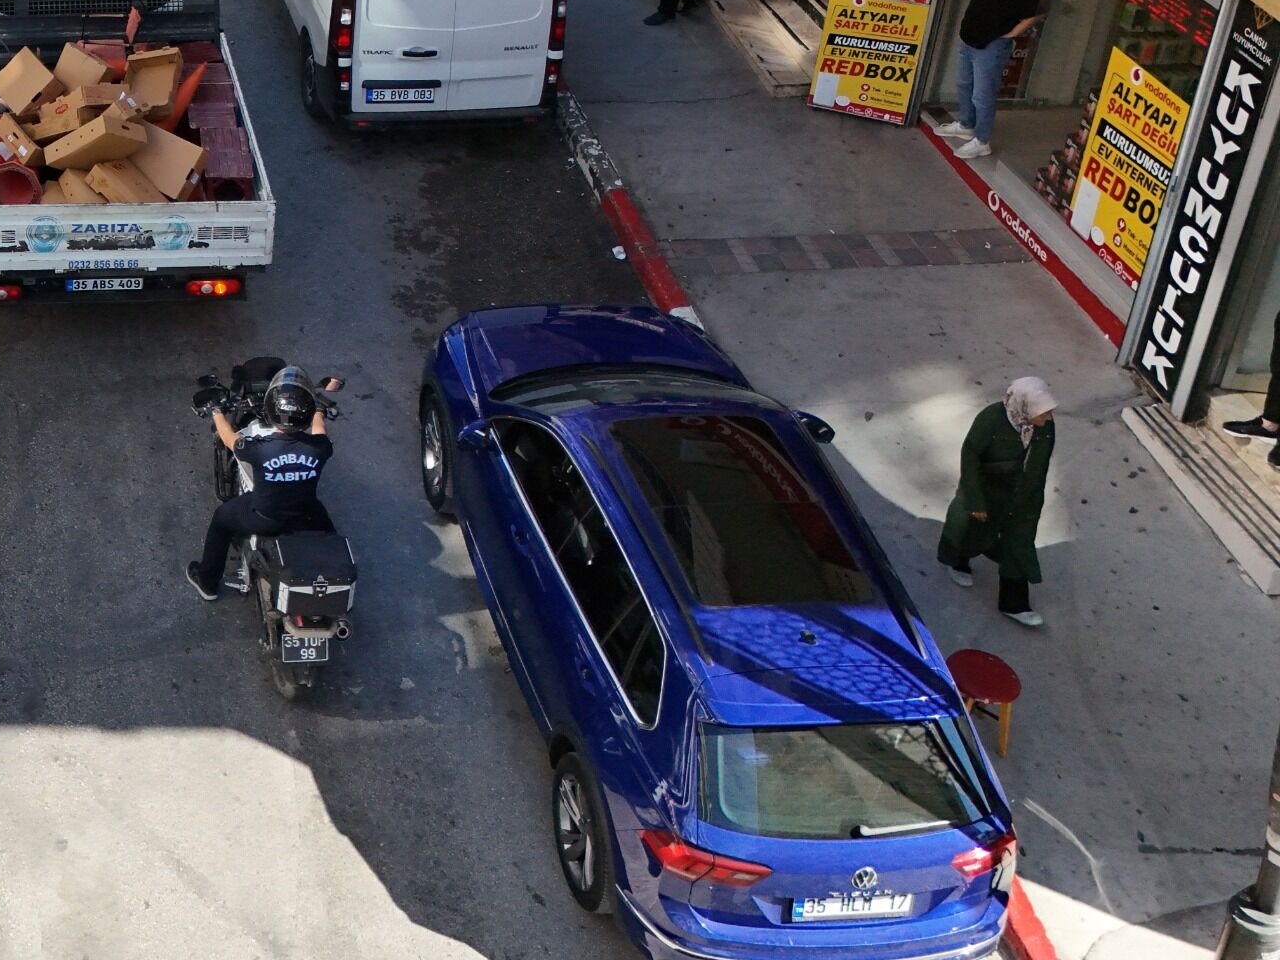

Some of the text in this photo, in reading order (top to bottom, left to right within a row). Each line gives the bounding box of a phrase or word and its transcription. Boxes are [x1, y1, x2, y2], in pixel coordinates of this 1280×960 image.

[867, 0, 907, 13] vodafone
[837, 8, 906, 25] ALTYAPI
[833, 19, 919, 38] ŞART DEĞİL!
[833, 35, 911, 54] KURULUMSUZ
[1244, 27, 1268, 50] CANSU
[503, 44, 540, 52] RENAULT
[830, 47, 847, 56] EV
[1232, 31, 1273, 66] KUYUMCULUK
[819, 57, 914, 84] REDBOX
[373, 90, 386, 101] 35
[1144, 78, 1182, 115] vodafone
[1112, 81, 1179, 135] ALTYAPI
[1106, 97, 1179, 158] ŞART DEĞİL
[1097, 143, 1112, 161] EV
[71, 222, 142, 234] ZABITA
[999, 205, 1048, 263] vodafone
[1140, 59, 1262, 391] KUYUMCULUK
[68, 259, 140, 270] 0232 856 66 66
[73, 278, 142, 290] 35 ABS 409
[262, 453, 319, 471] TORBALI
[264, 469, 317, 482] ZABITA
[300, 648, 317, 660] 99
[805, 898, 826, 914] 35
[840, 897, 873, 913] HLM
[889, 894, 909, 911] 17
